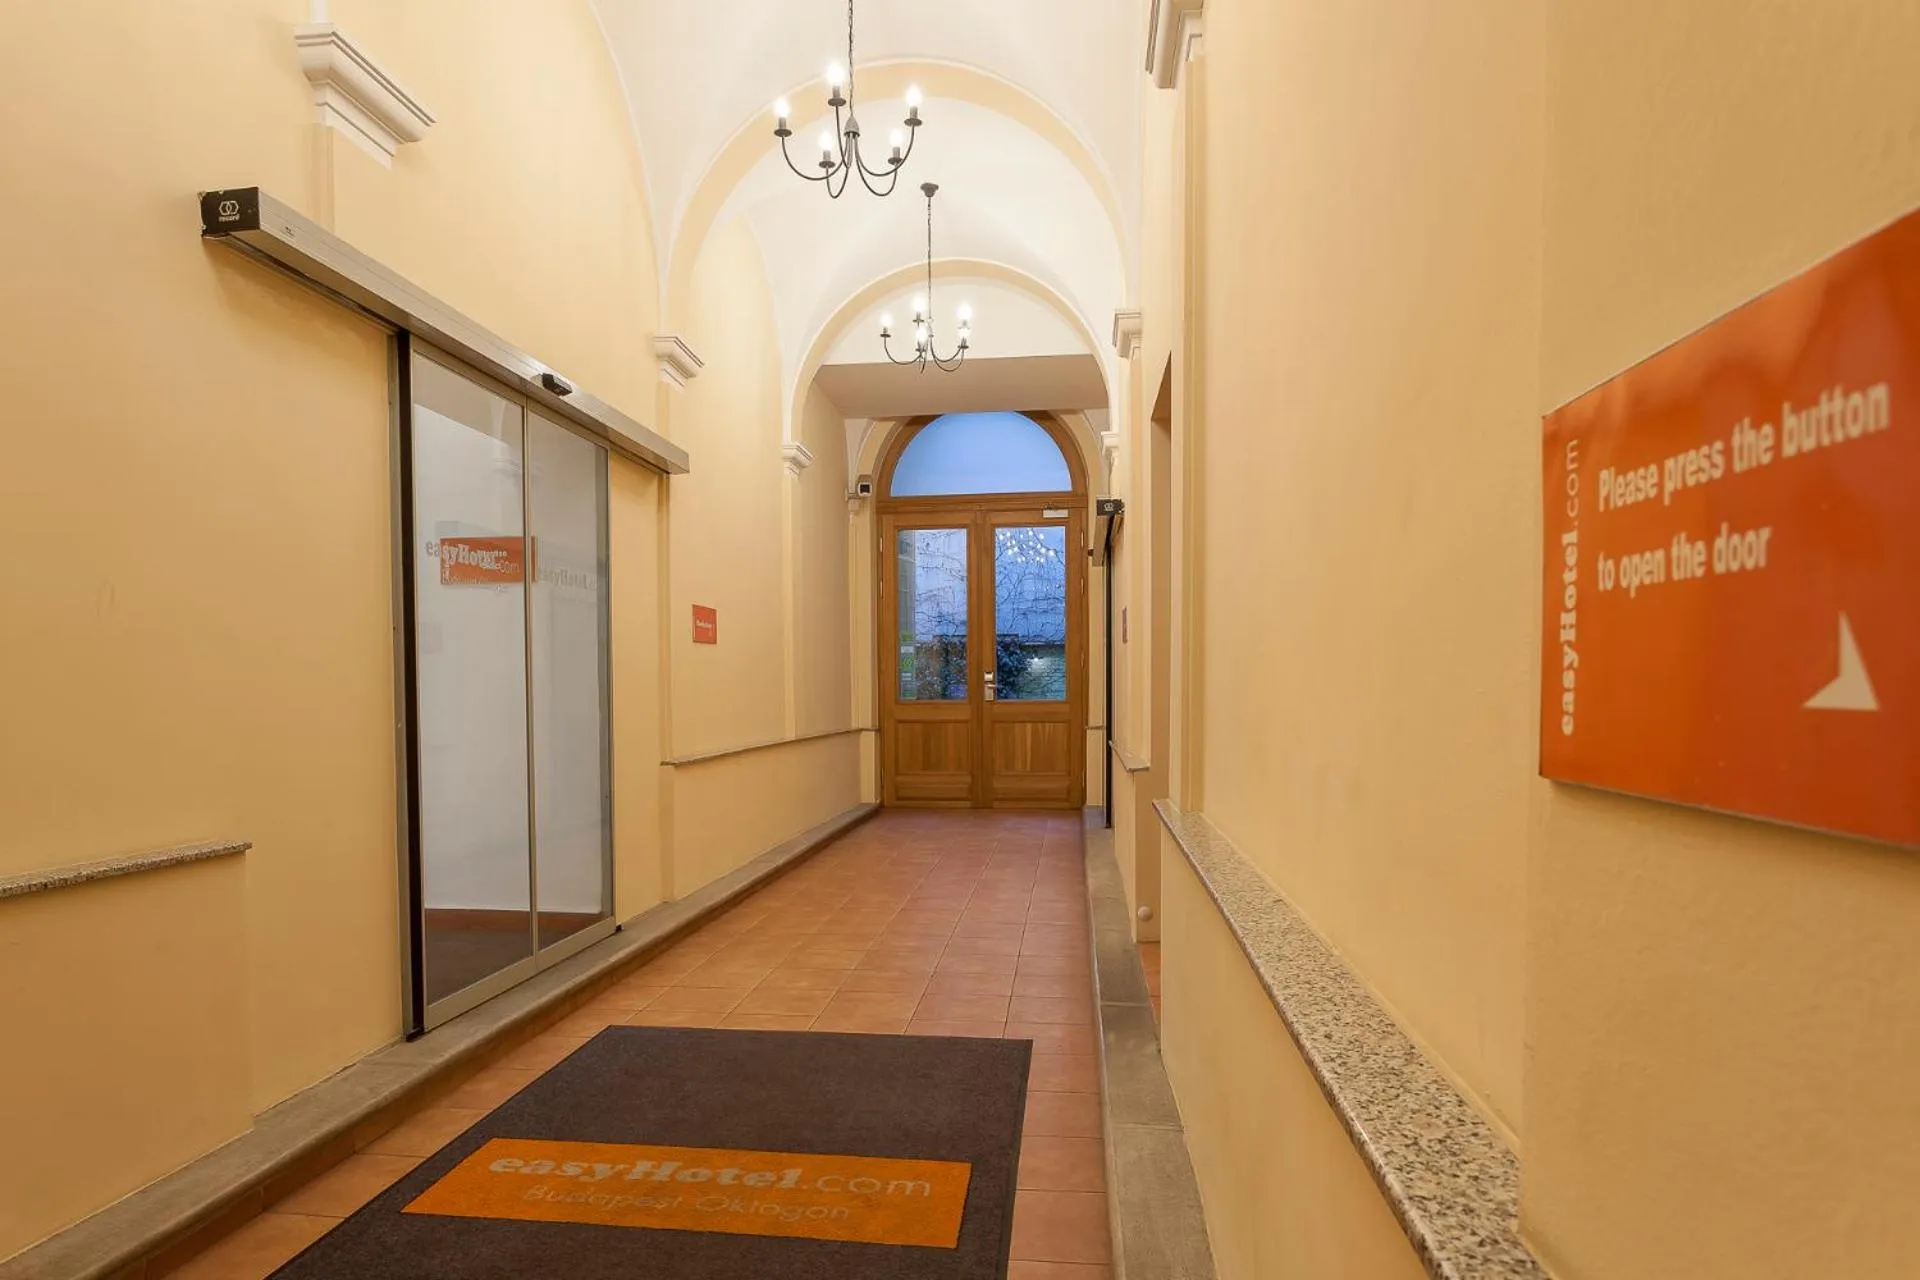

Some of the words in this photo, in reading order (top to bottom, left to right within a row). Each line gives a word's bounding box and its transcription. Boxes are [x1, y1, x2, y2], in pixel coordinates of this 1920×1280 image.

[1599, 467, 1658, 512] Please
[1663, 439, 1725, 506] press
[1731, 416, 1775, 473] the
[1781, 382, 1890, 458] button
[1560, 439, 1579, 736] easyHotel.com
[1597, 550, 1615, 592] to
[1619, 547, 1666, 599] open
[1671, 531, 1707, 581] the
[1712, 521, 1773, 574] door
[488, 1157, 932, 1198] easyHotel.com
